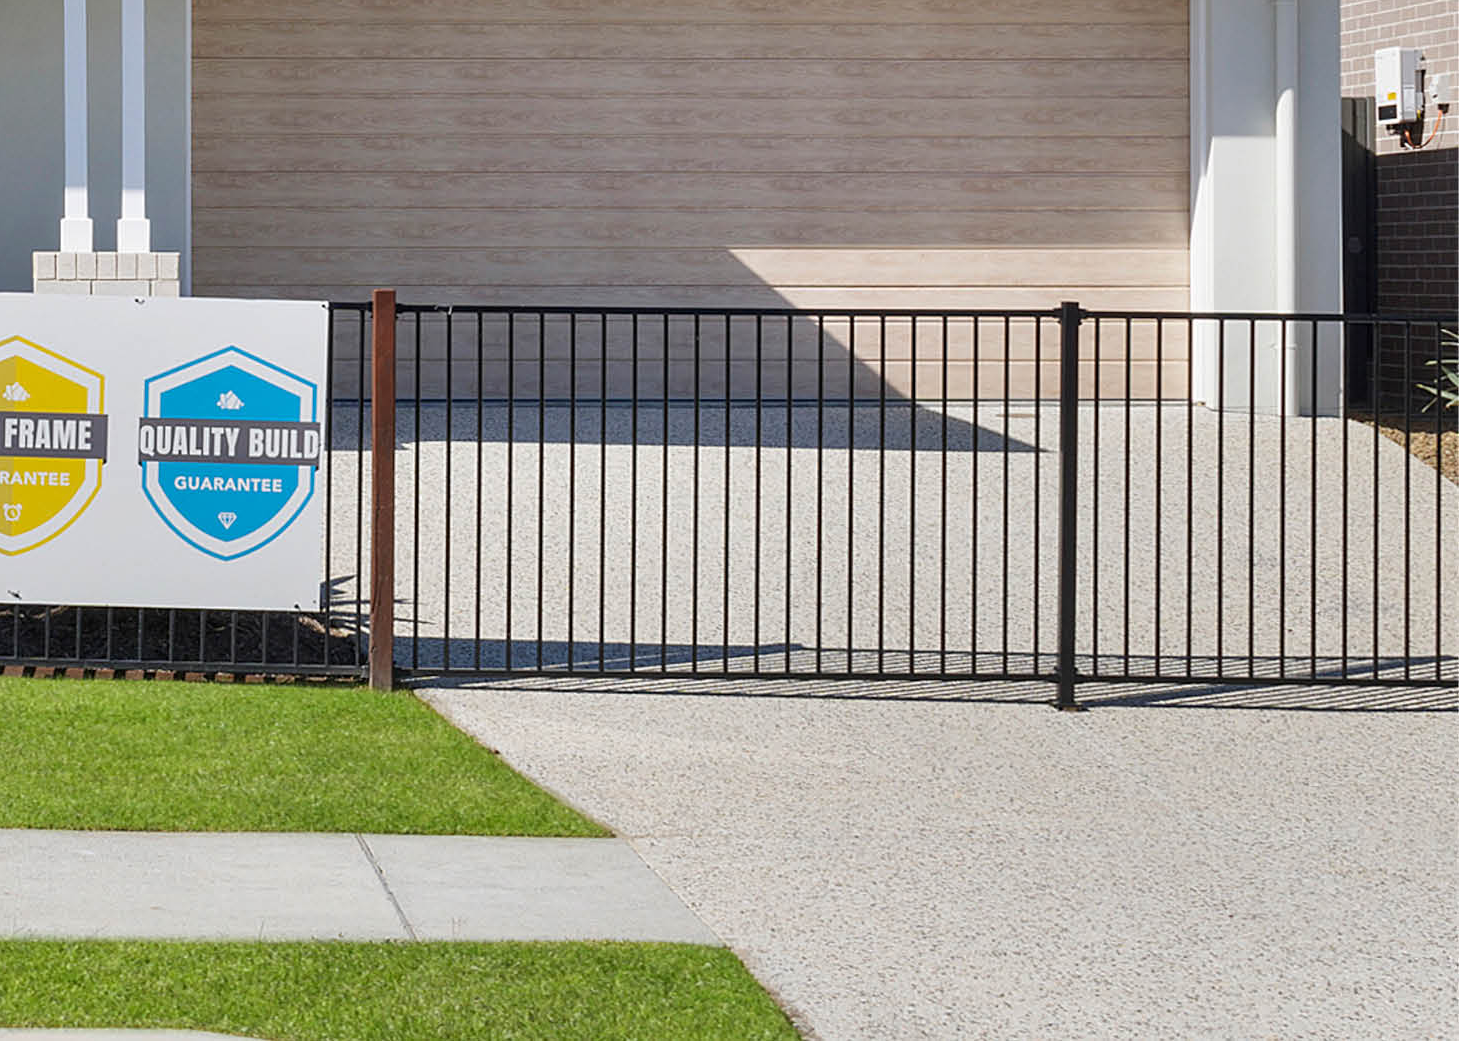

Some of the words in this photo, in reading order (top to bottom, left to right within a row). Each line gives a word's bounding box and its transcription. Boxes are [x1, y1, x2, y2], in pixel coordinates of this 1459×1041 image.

[4, 417, 92, 450] FRAME
[139, 424, 240, 457] QUALITY
[248, 427, 320, 460] BUILD
[173, 475, 283, 493] GUARANTEE
